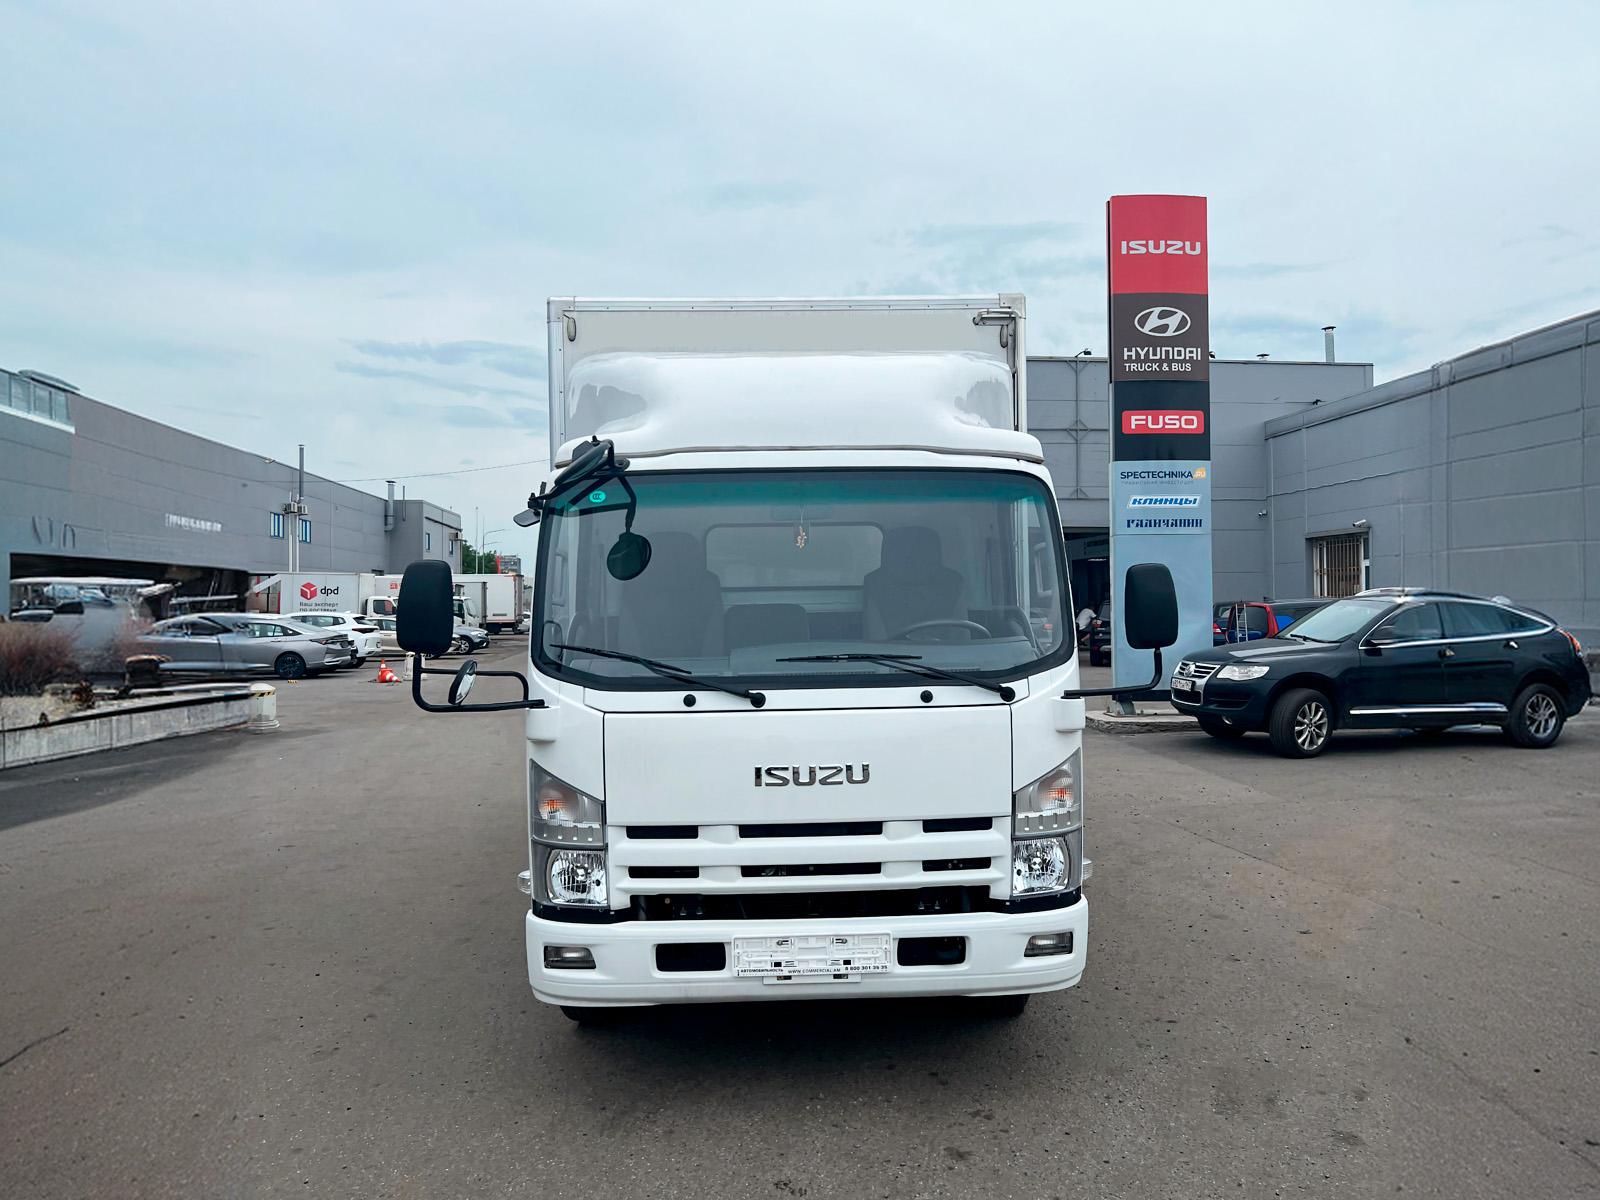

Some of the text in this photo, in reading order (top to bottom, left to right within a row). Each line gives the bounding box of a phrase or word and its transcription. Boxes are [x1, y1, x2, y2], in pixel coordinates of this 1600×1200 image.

[1121, 240, 1201, 255] ISUZU
[1123, 347, 1201, 360] HYUNDAI
[1124, 363, 1192, 372] TRUCK & BUS
[1131, 415, 1198, 429] FUSO
[1131, 498, 1198, 506] КЛИНЦЫ
[320, 586, 339, 596] dpd
[754, 762, 870, 787] ISUZU
